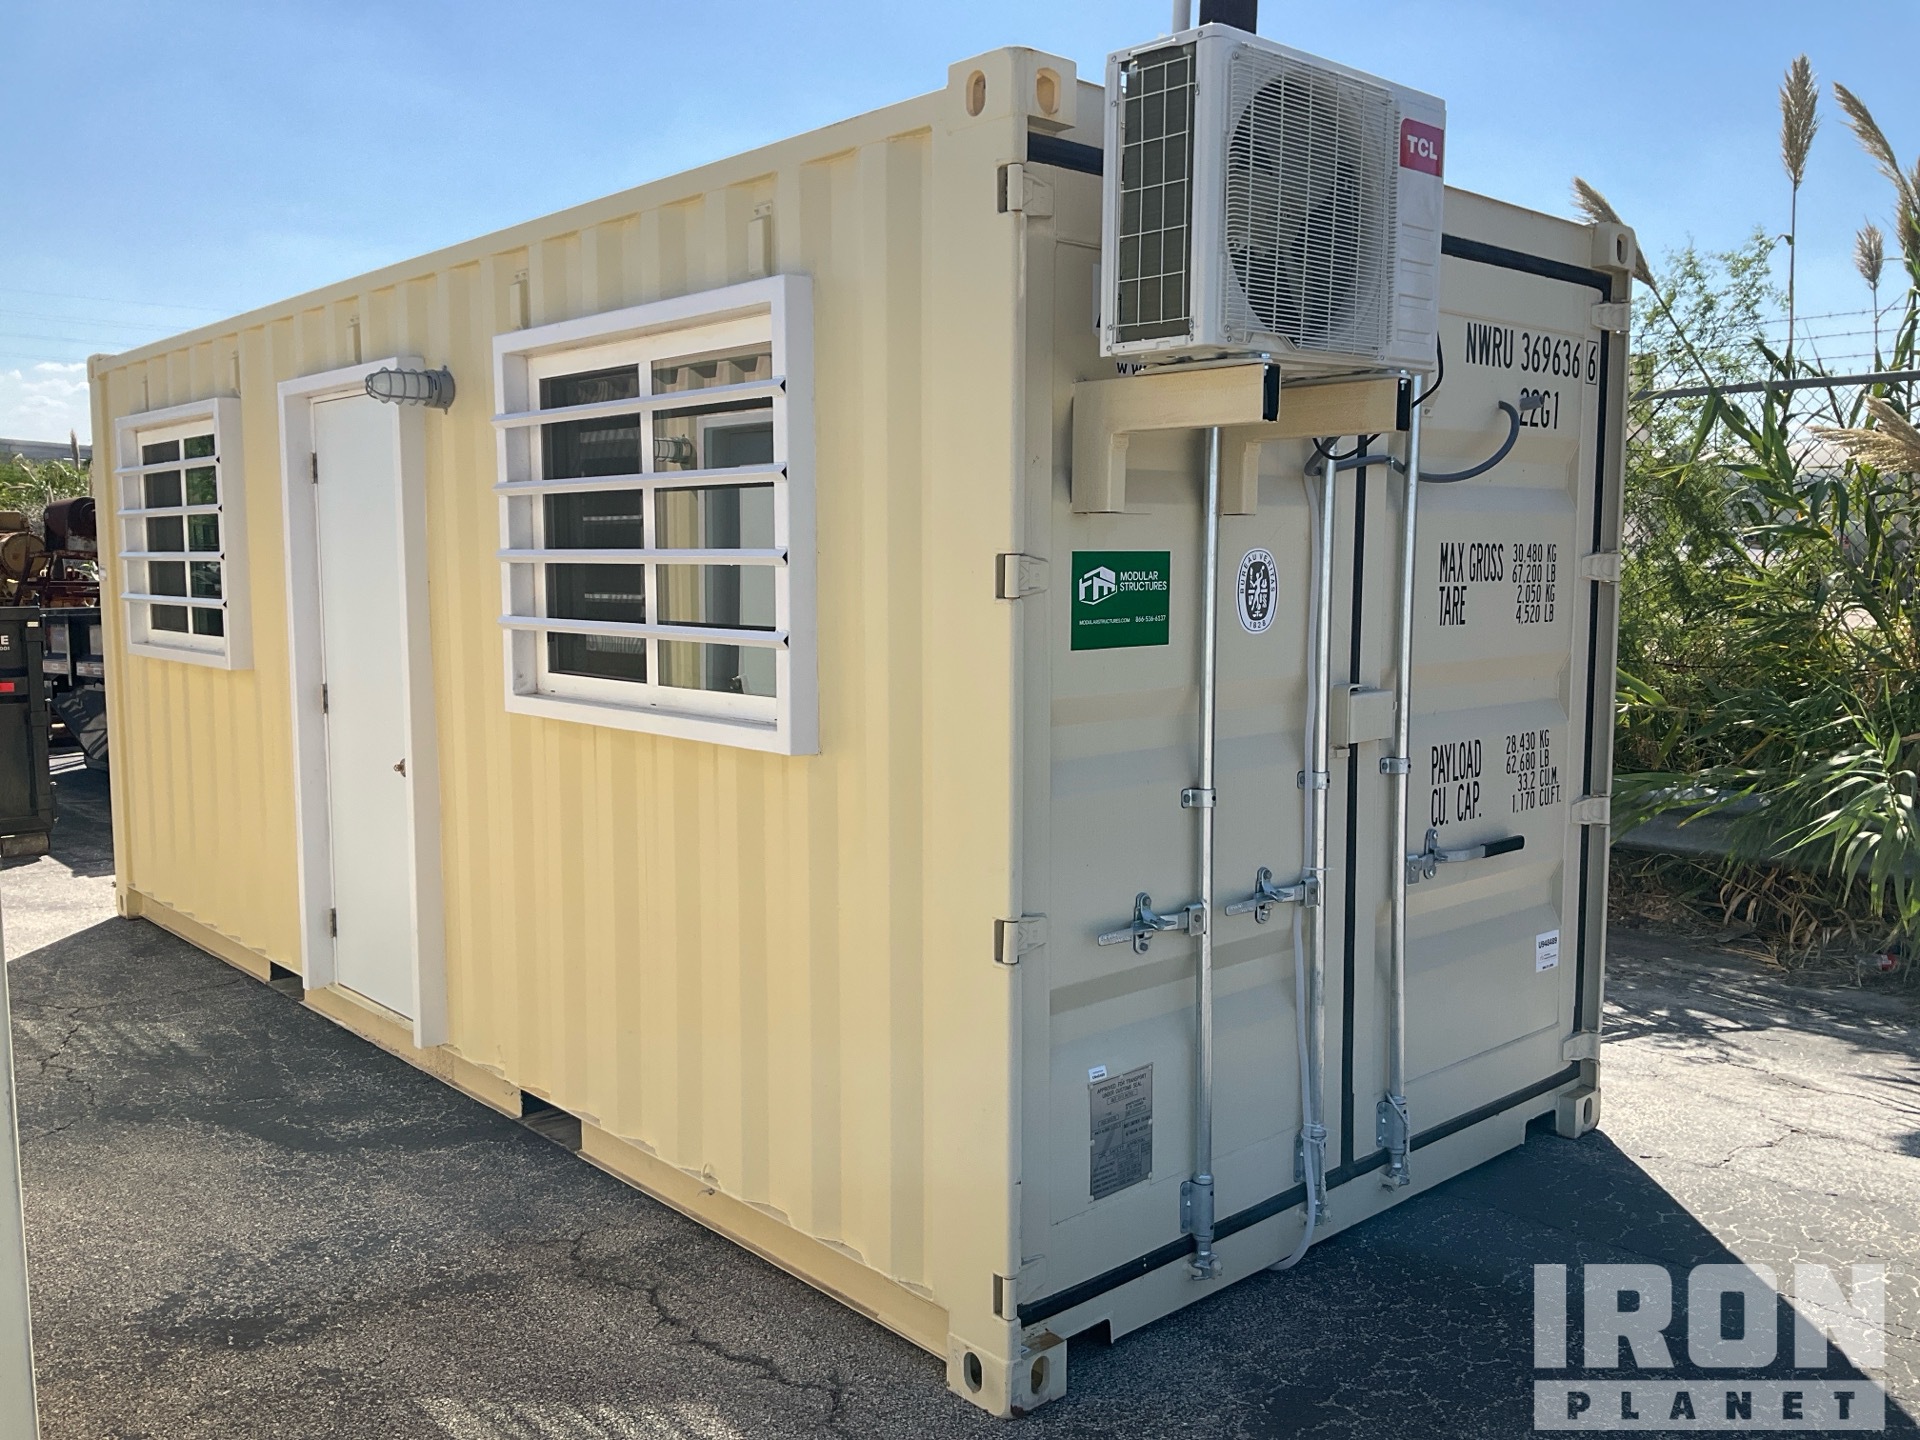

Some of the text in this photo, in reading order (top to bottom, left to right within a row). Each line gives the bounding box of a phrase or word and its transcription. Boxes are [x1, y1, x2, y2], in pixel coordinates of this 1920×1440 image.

[1407, 135, 1438, 160] TCL
[1466, 322, 1596, 381] NWRU 369636 6
[1439, 543, 1557, 582] MAX GROSS 30,480 KG
[1512, 564, 1556, 583] 67,200 LB
[1120, 571, 1159, 581] MODULAR
[1120, 581, 1168, 591] STRUCTURES
[1439, 584, 1556, 626] TARE 2,050 KG
[1544, 604, 1554, 623] LB
[1249, 620, 1267, 629] 1828
[1431, 739, 1482, 785] PAYLOAD
[1539, 729, 1550, 748] KG
[1540, 749, 1550, 768] LB
[1430, 787, 1449, 827] CU.
[1457, 781, 1482, 821] CAP.
[1517, 771, 1535, 792] 33.2
